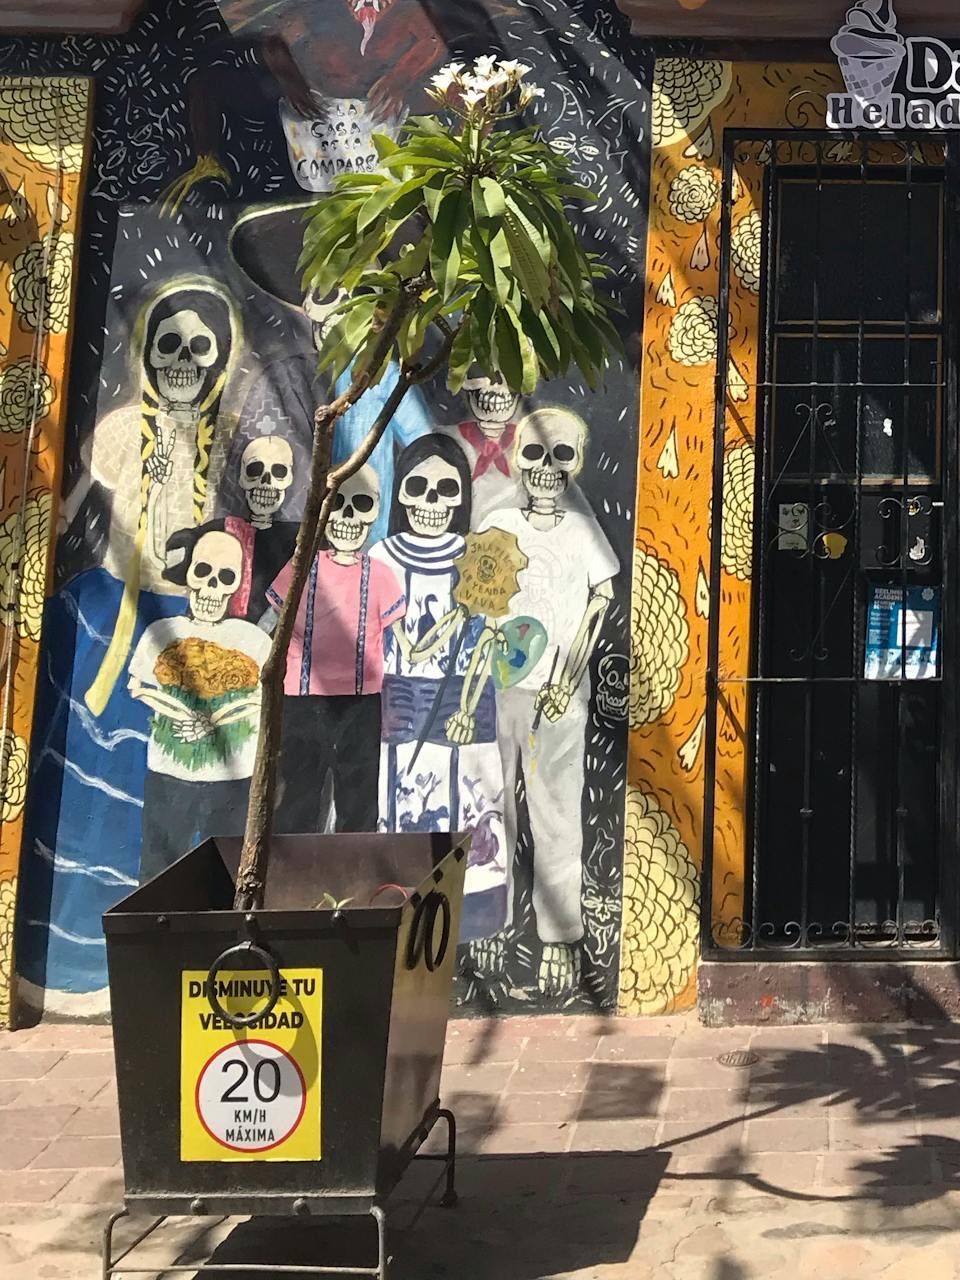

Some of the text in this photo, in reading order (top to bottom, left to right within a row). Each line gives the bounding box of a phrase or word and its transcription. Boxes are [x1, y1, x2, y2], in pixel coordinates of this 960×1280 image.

[336, 103, 358, 116] LA
[310, 121, 361, 139] CASA
[296, 154, 380, 181] COMPARS
[292, 978, 316, 997] TU
[220, 1058, 281, 1103] 20
[234, 1108, 267, 1125] KM/H
[225, 1124, 275, 1142] MÁXIMA
